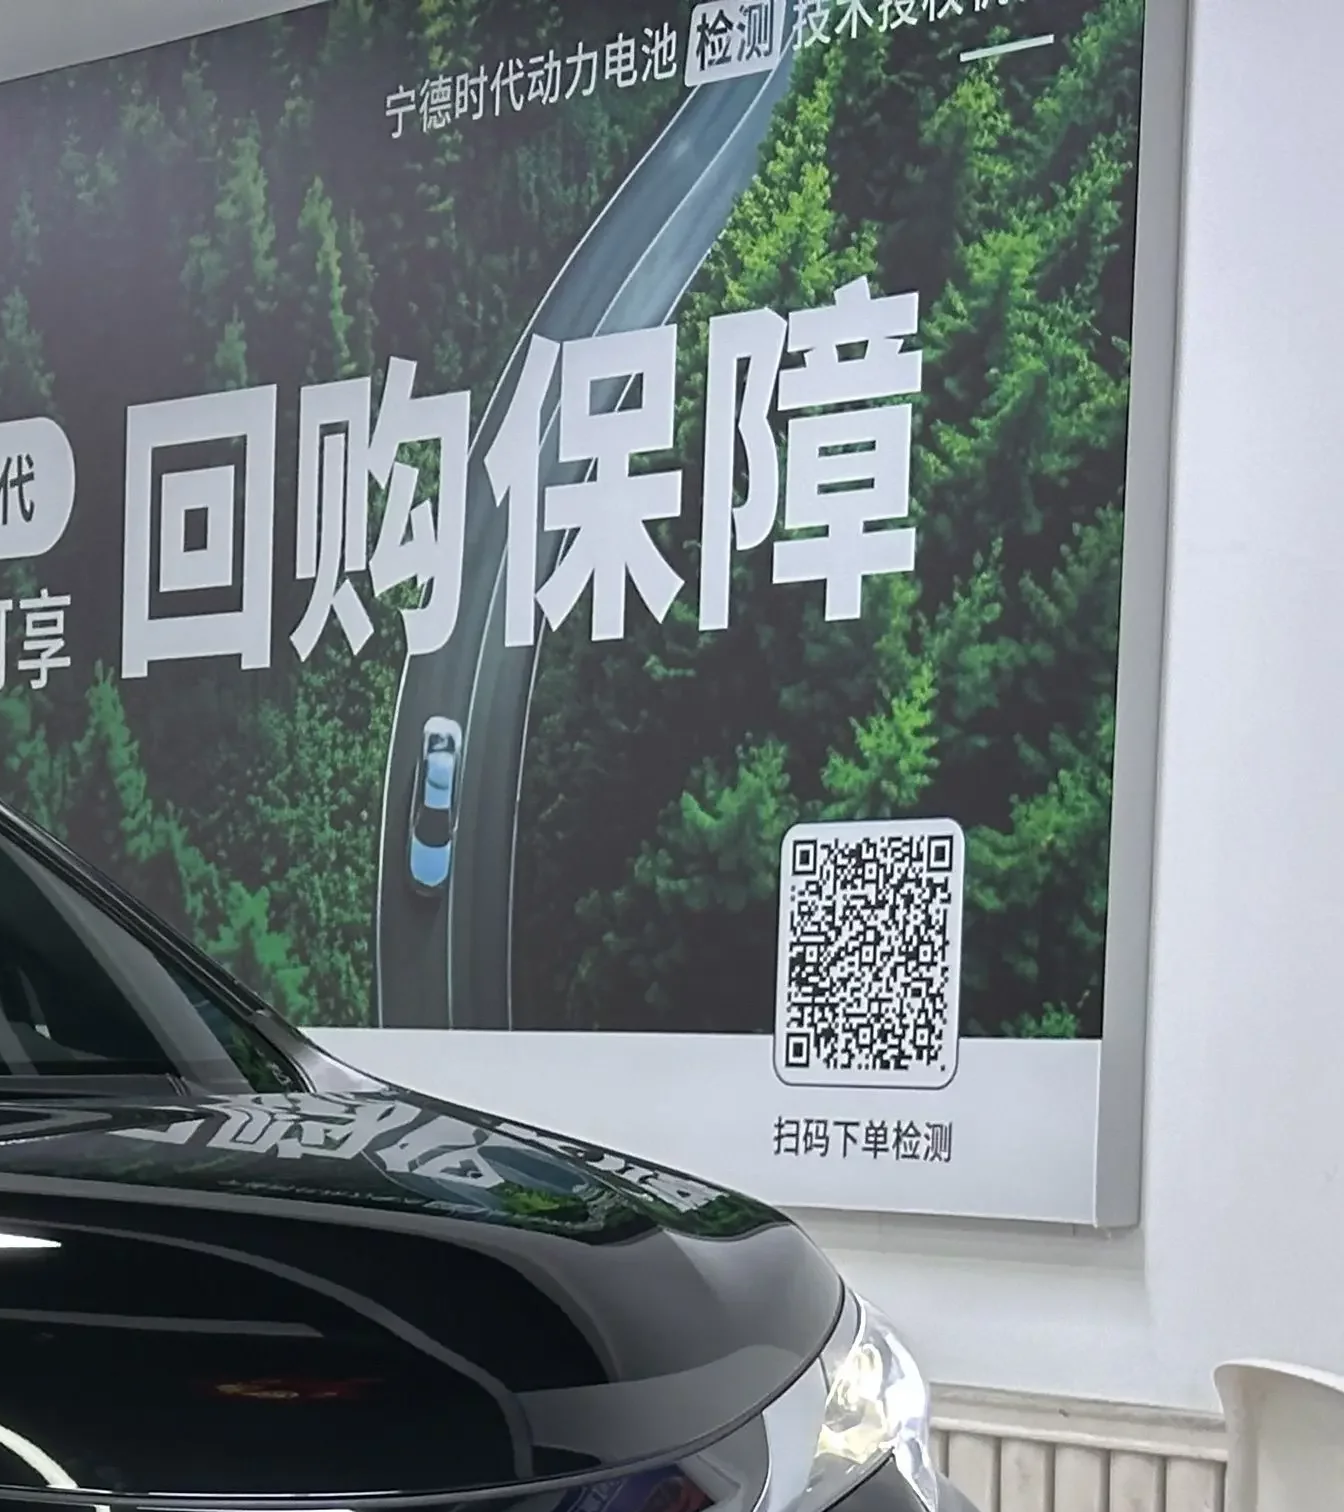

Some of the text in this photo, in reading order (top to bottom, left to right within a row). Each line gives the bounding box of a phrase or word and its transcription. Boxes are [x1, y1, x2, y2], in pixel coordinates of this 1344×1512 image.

[385, 28, 678, 139] 宁德时代动力电池
[696, 2, 774, 71] 检测
[121, 275, 923, 679] 回购保障
[772, 1114, 953, 1163] 扫码下单检测
